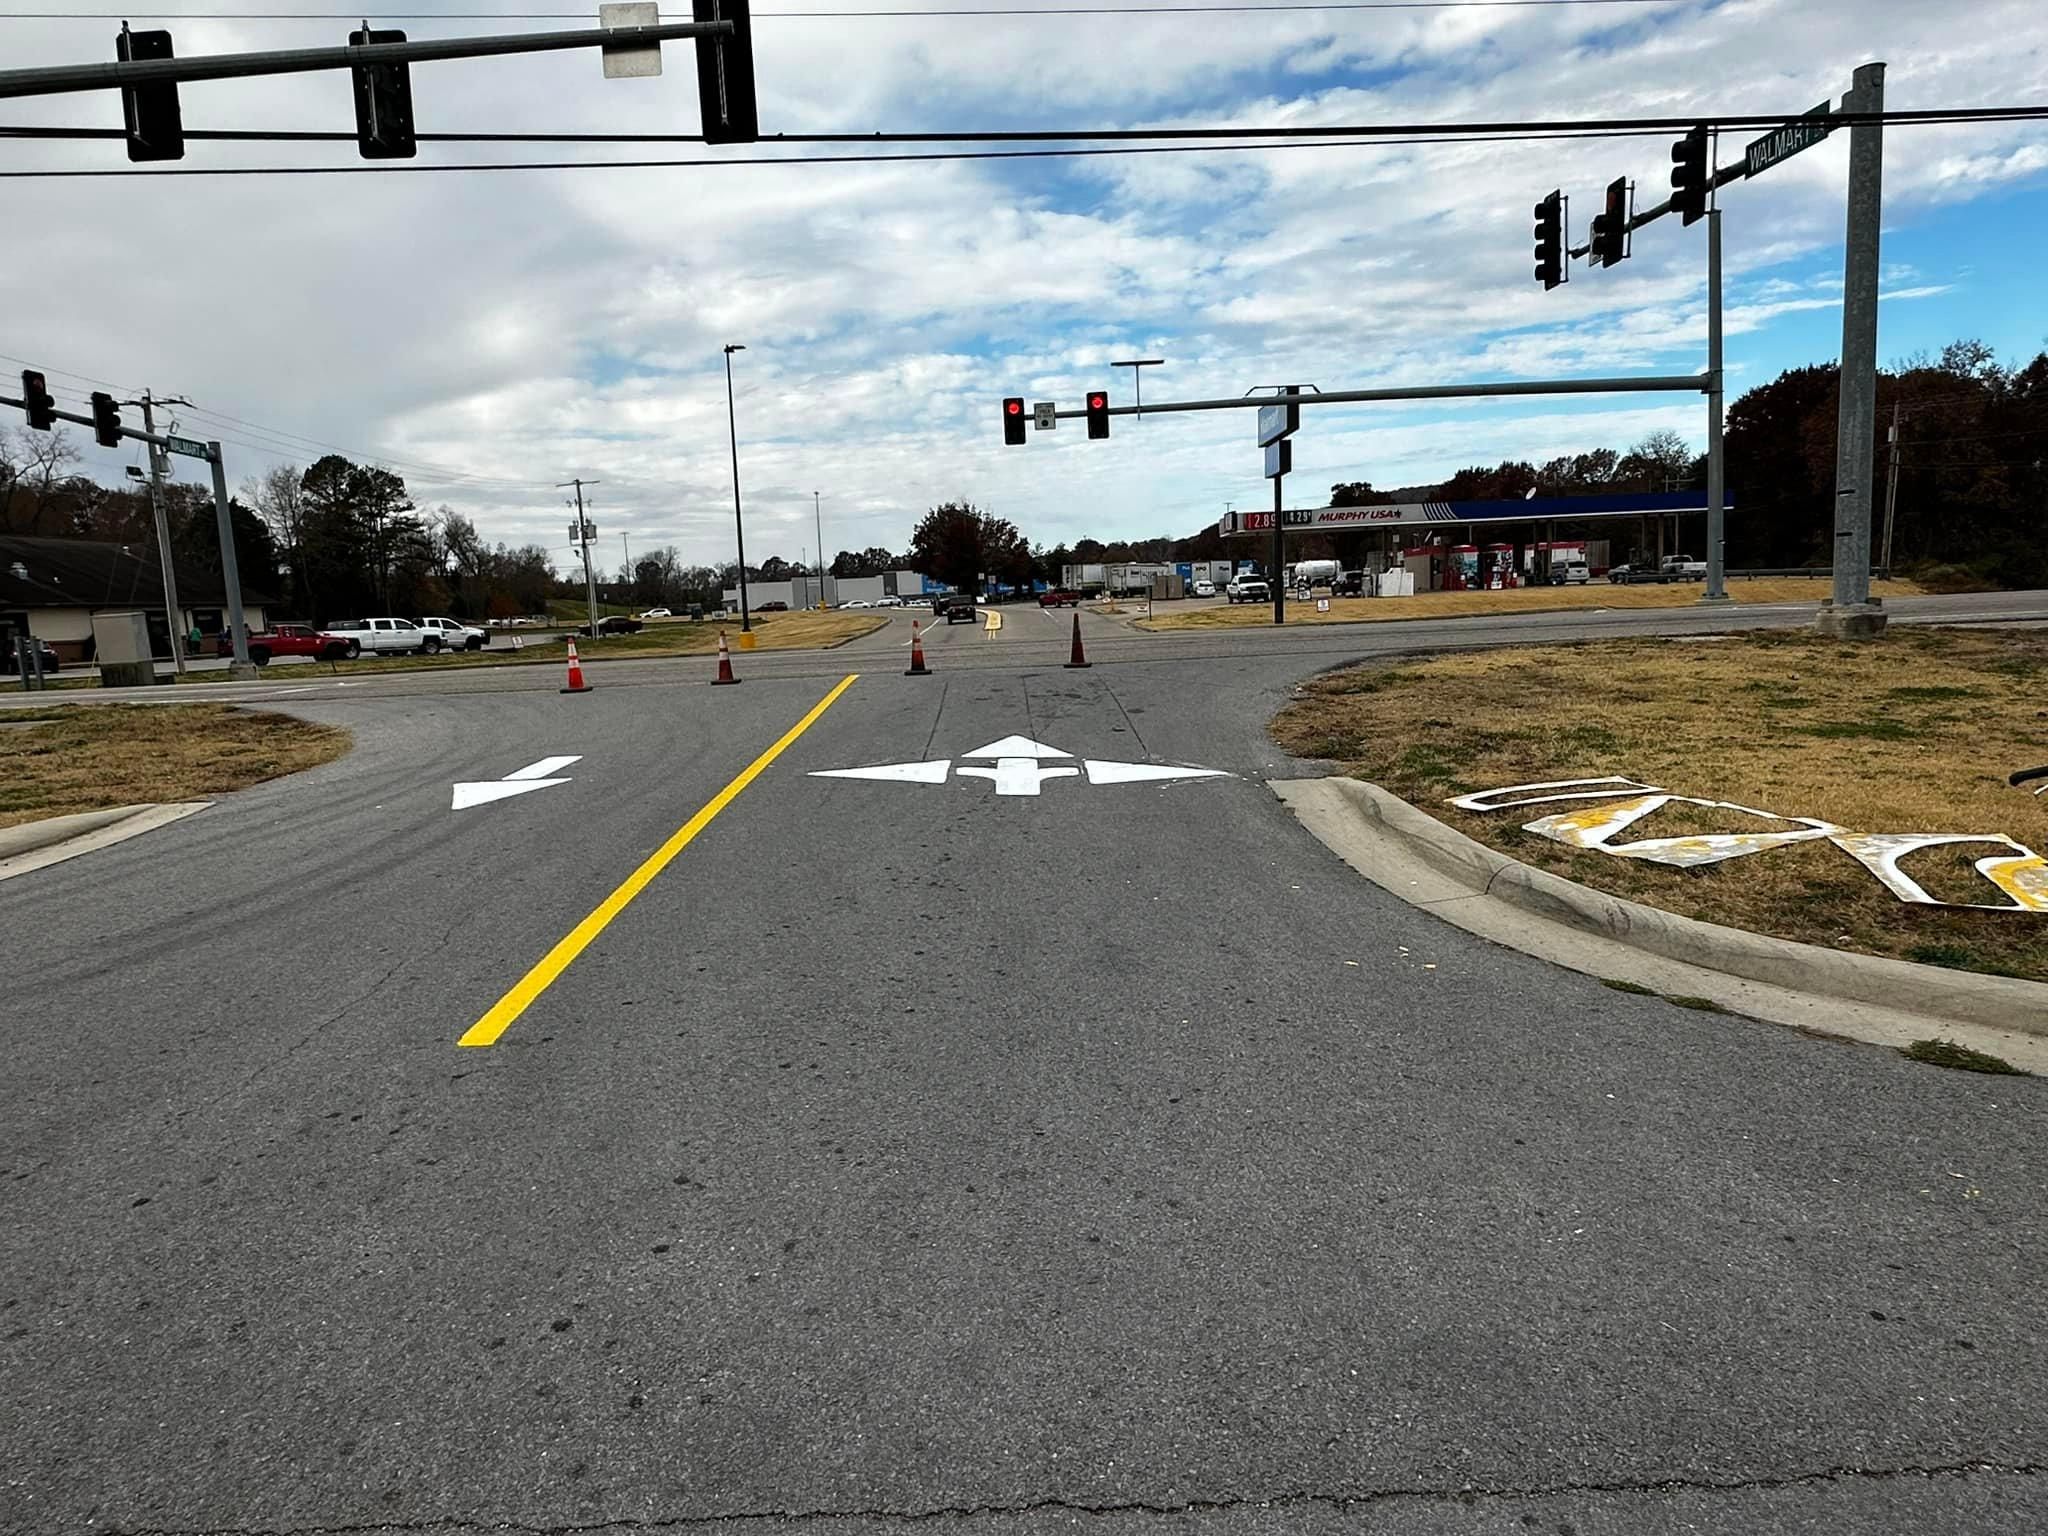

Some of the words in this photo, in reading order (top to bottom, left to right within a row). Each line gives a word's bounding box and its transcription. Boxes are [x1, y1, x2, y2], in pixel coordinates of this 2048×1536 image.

[1748, 122, 1810, 171] WALMART
[1317, 511, 1369, 523] MURPHY
[1370, 508, 1396, 519] USA
